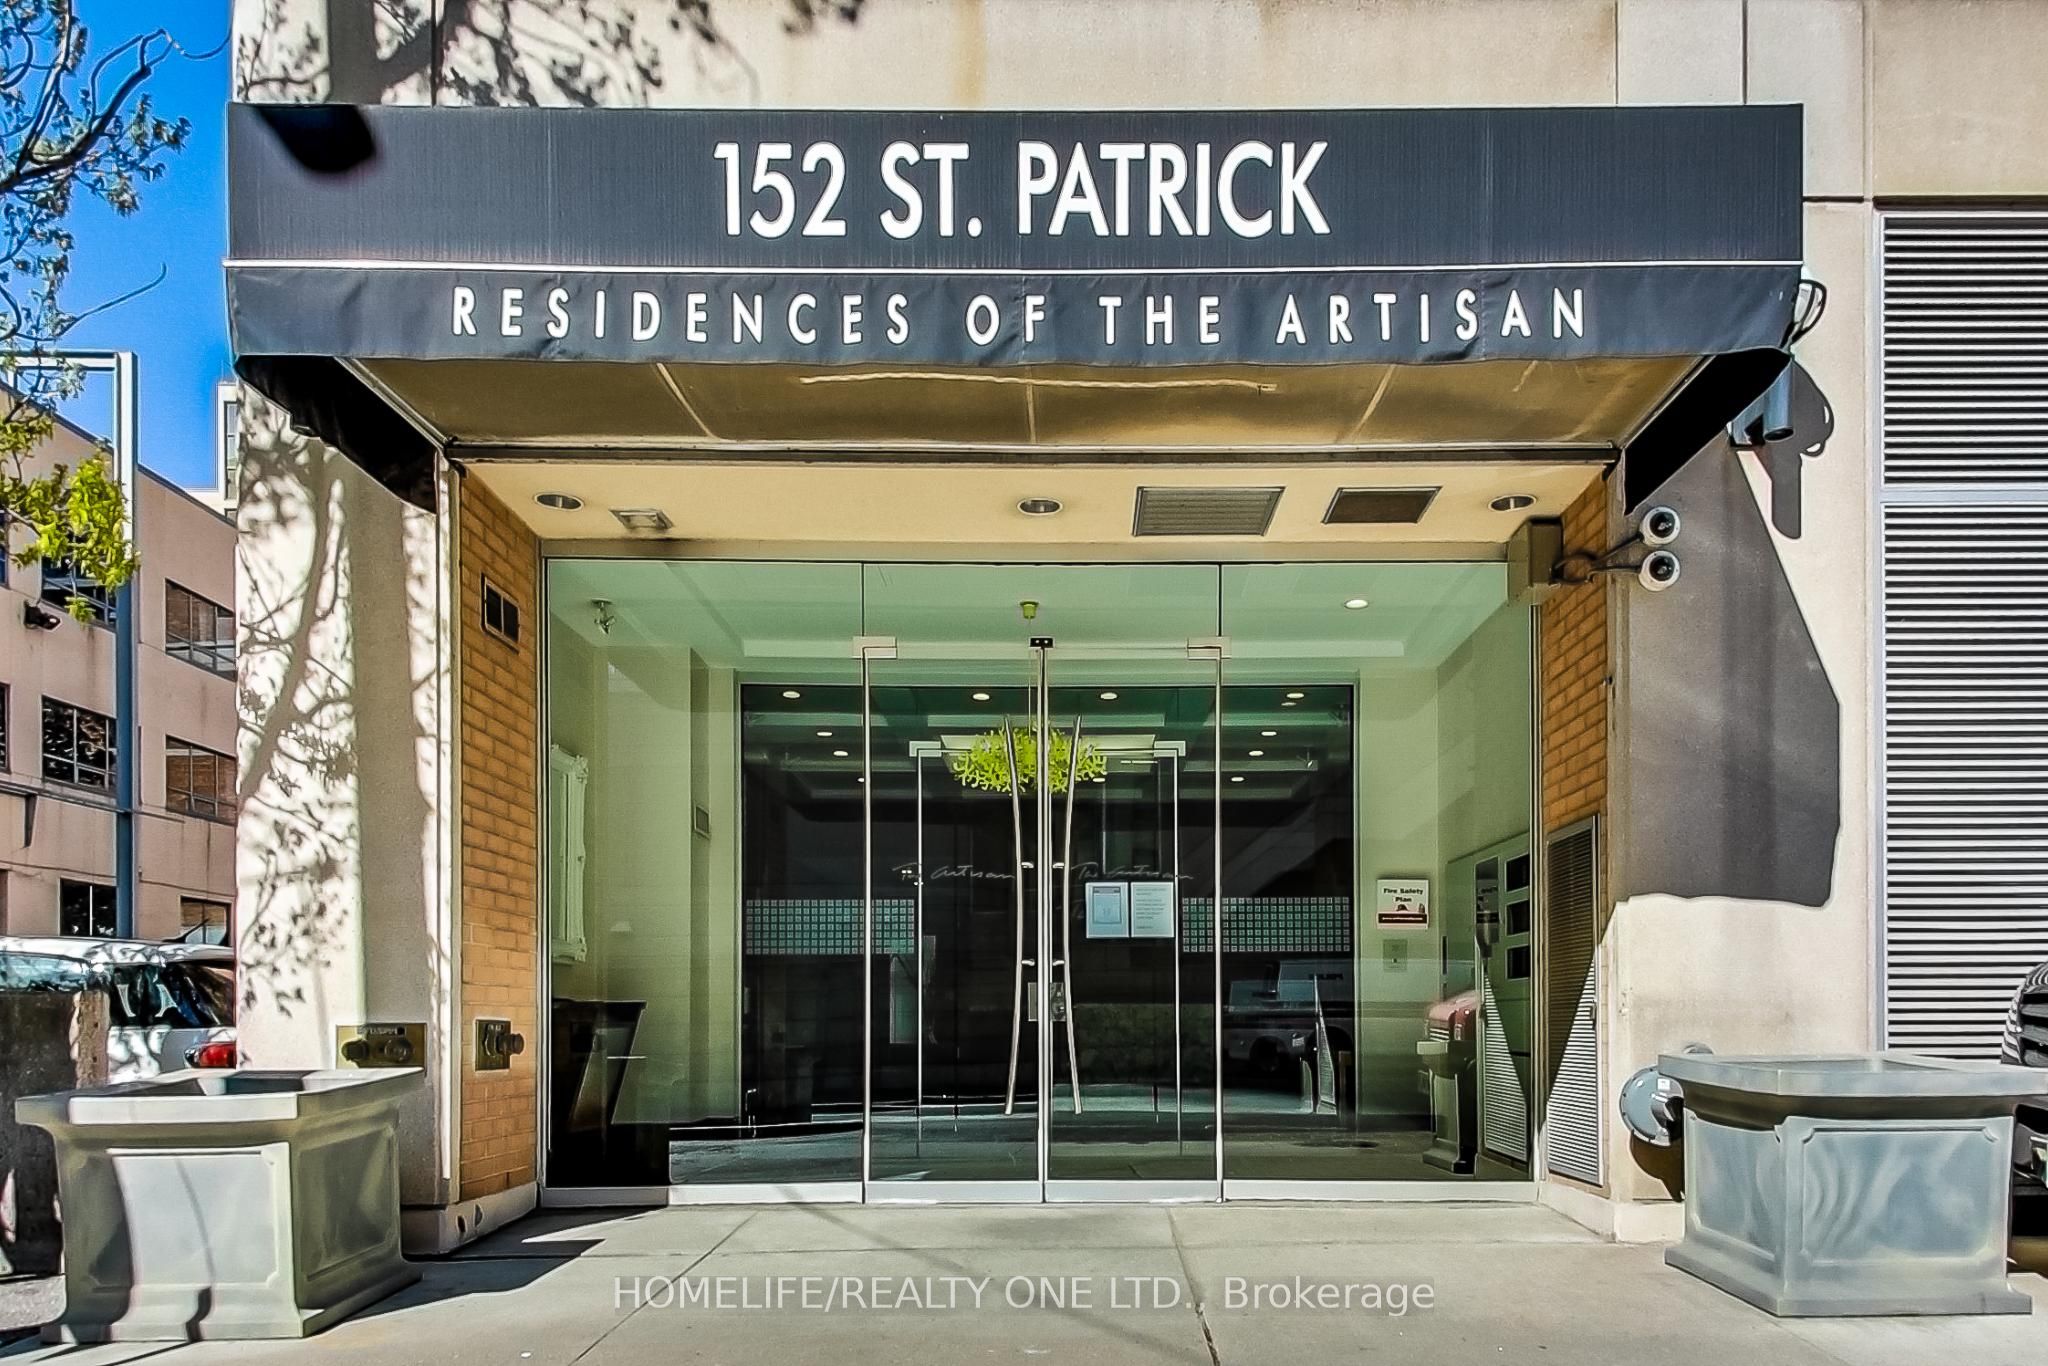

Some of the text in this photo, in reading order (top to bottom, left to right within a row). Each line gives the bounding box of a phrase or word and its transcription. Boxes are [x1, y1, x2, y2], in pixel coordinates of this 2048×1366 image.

[713, 139, 1331, 240] 152 ST. PATRICK
[452, 286, 1584, 346] RESIDENCES OF THE ARTISAN
